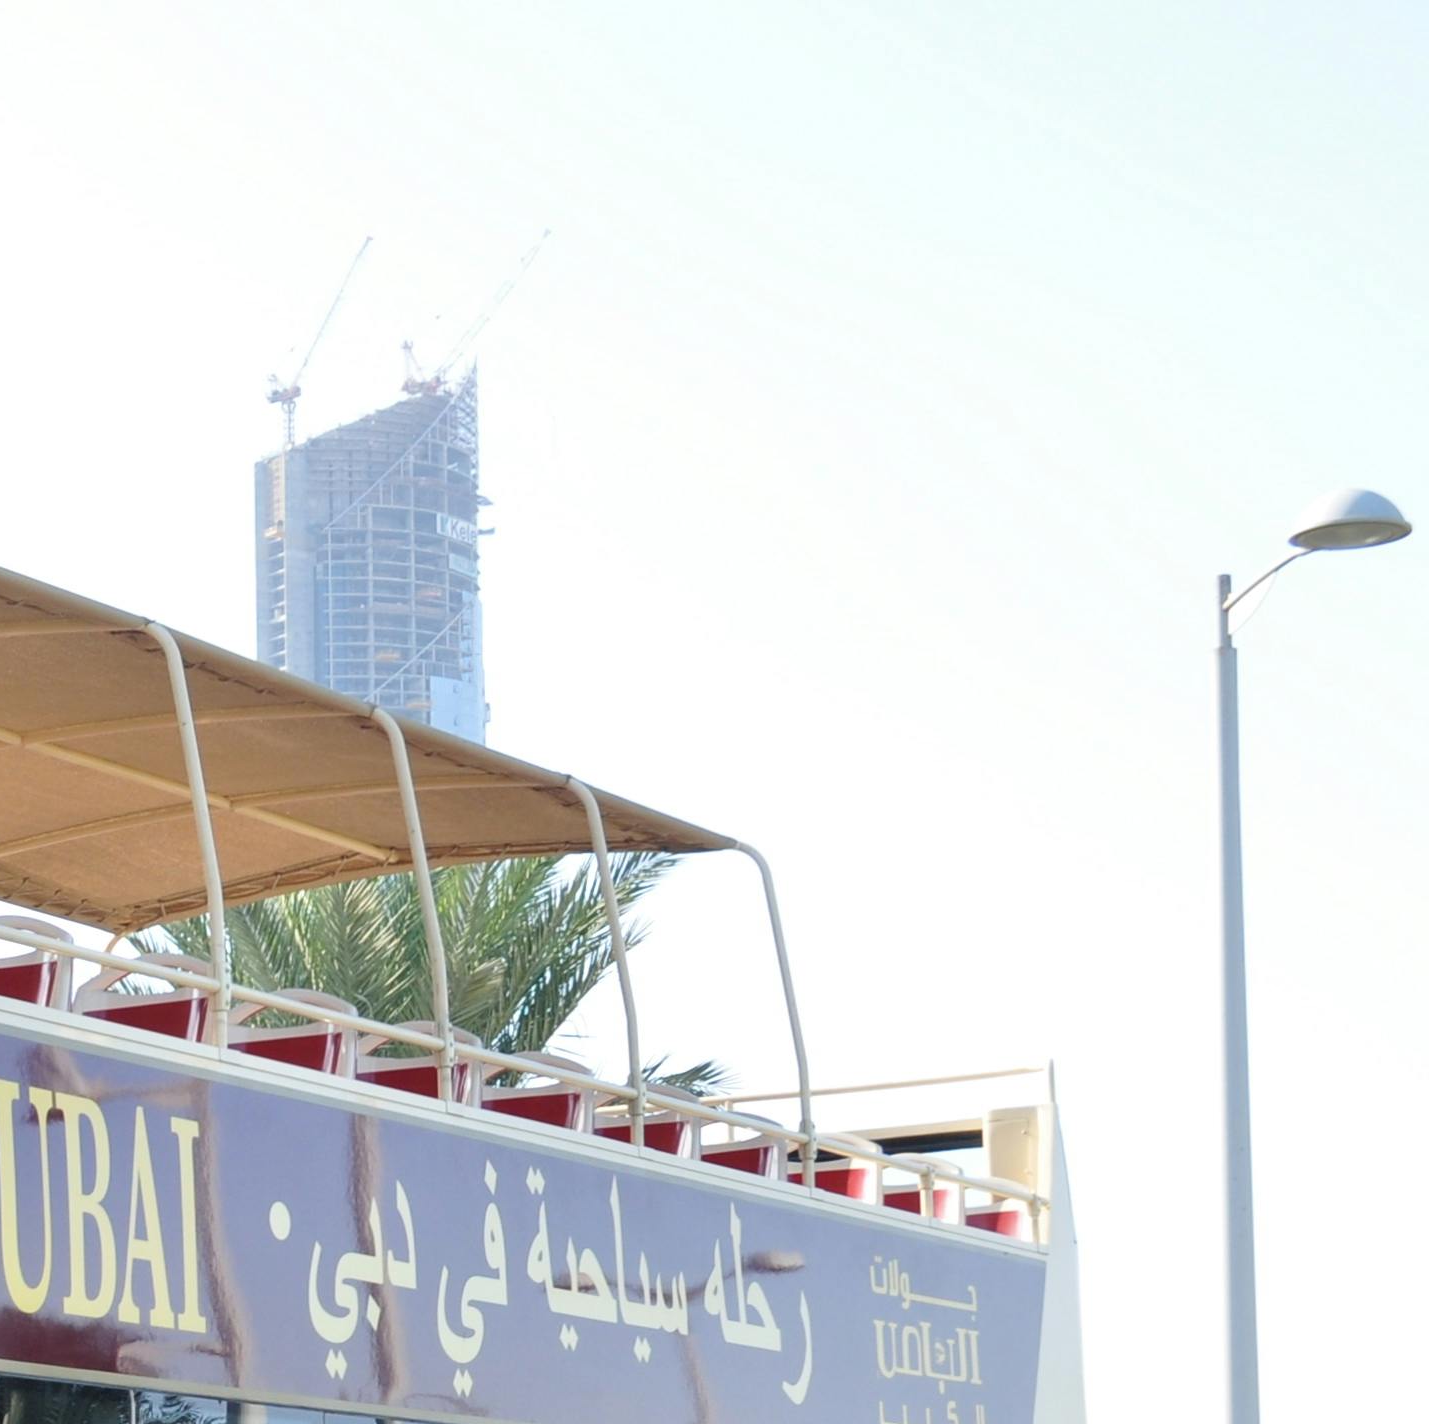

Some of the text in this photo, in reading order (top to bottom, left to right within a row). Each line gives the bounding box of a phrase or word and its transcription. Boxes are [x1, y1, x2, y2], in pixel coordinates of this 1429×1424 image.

[308, 1179, 417, 1381] دبي
[437, 1159, 508, 1398] في
[527, 1165, 689, 1363] سياحية
[870, 1255, 978, 1322] جولات
[873, 1319, 982, 1394] الباص
